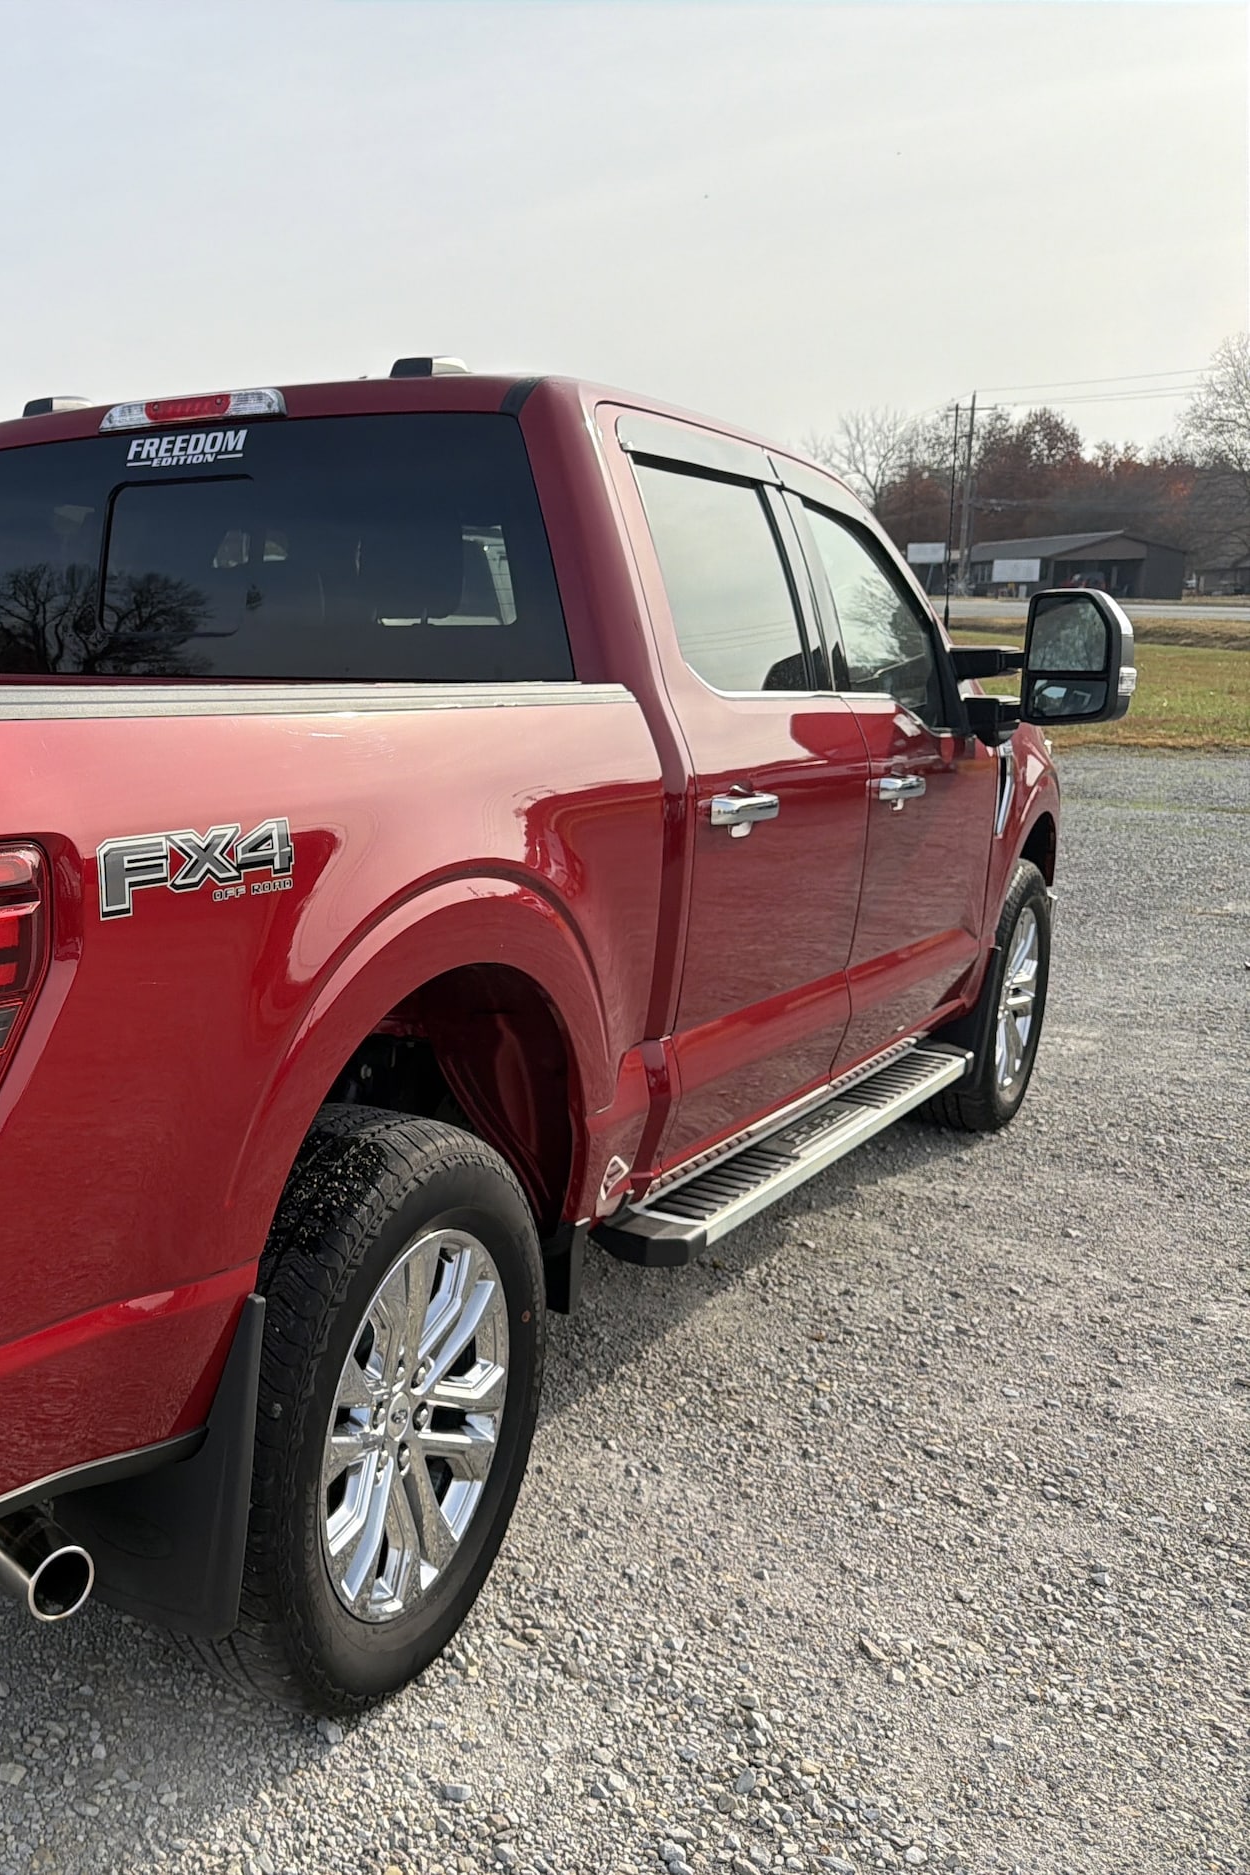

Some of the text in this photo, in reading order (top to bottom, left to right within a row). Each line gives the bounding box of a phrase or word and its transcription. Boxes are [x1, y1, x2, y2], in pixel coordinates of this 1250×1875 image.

[127, 429, 247, 460] FREEDOM
[151, 453, 216, 467] EDITION
[96, 817, 294, 921] FX4
[212, 878, 293, 901] OFF ROAD
